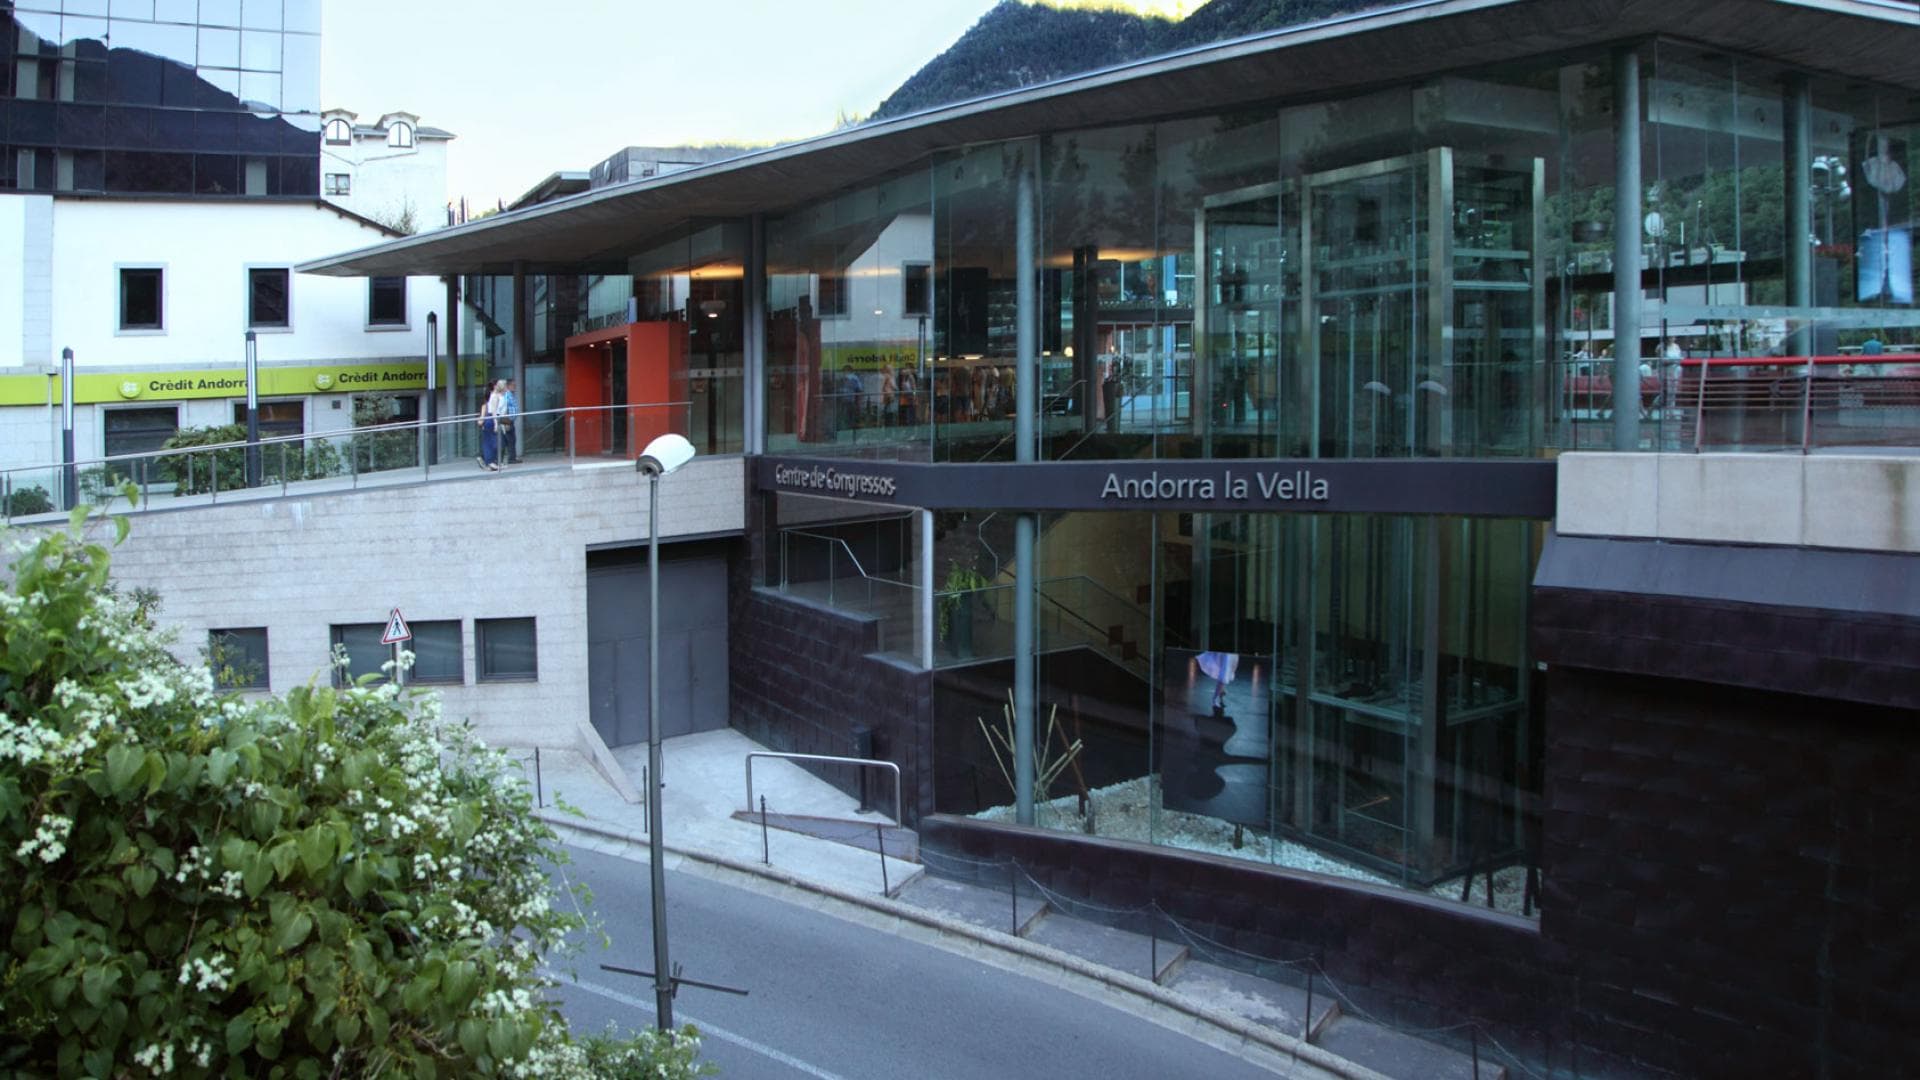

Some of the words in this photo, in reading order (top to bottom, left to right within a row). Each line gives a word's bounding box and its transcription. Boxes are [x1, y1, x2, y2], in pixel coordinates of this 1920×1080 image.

[149, 379, 193, 391] Crèdit
[339, 371, 378, 383] Crèdit
[382, 369, 428, 382] Andorr
[775, 463, 809, 487] Centre
[810, 465, 824, 489] de
[826, 467, 896, 497] Congressos
[1101, 471, 1215, 499] Andorra
[1225, 470, 1248, 499] la
[1256, 470, 1329, 500] Vella
